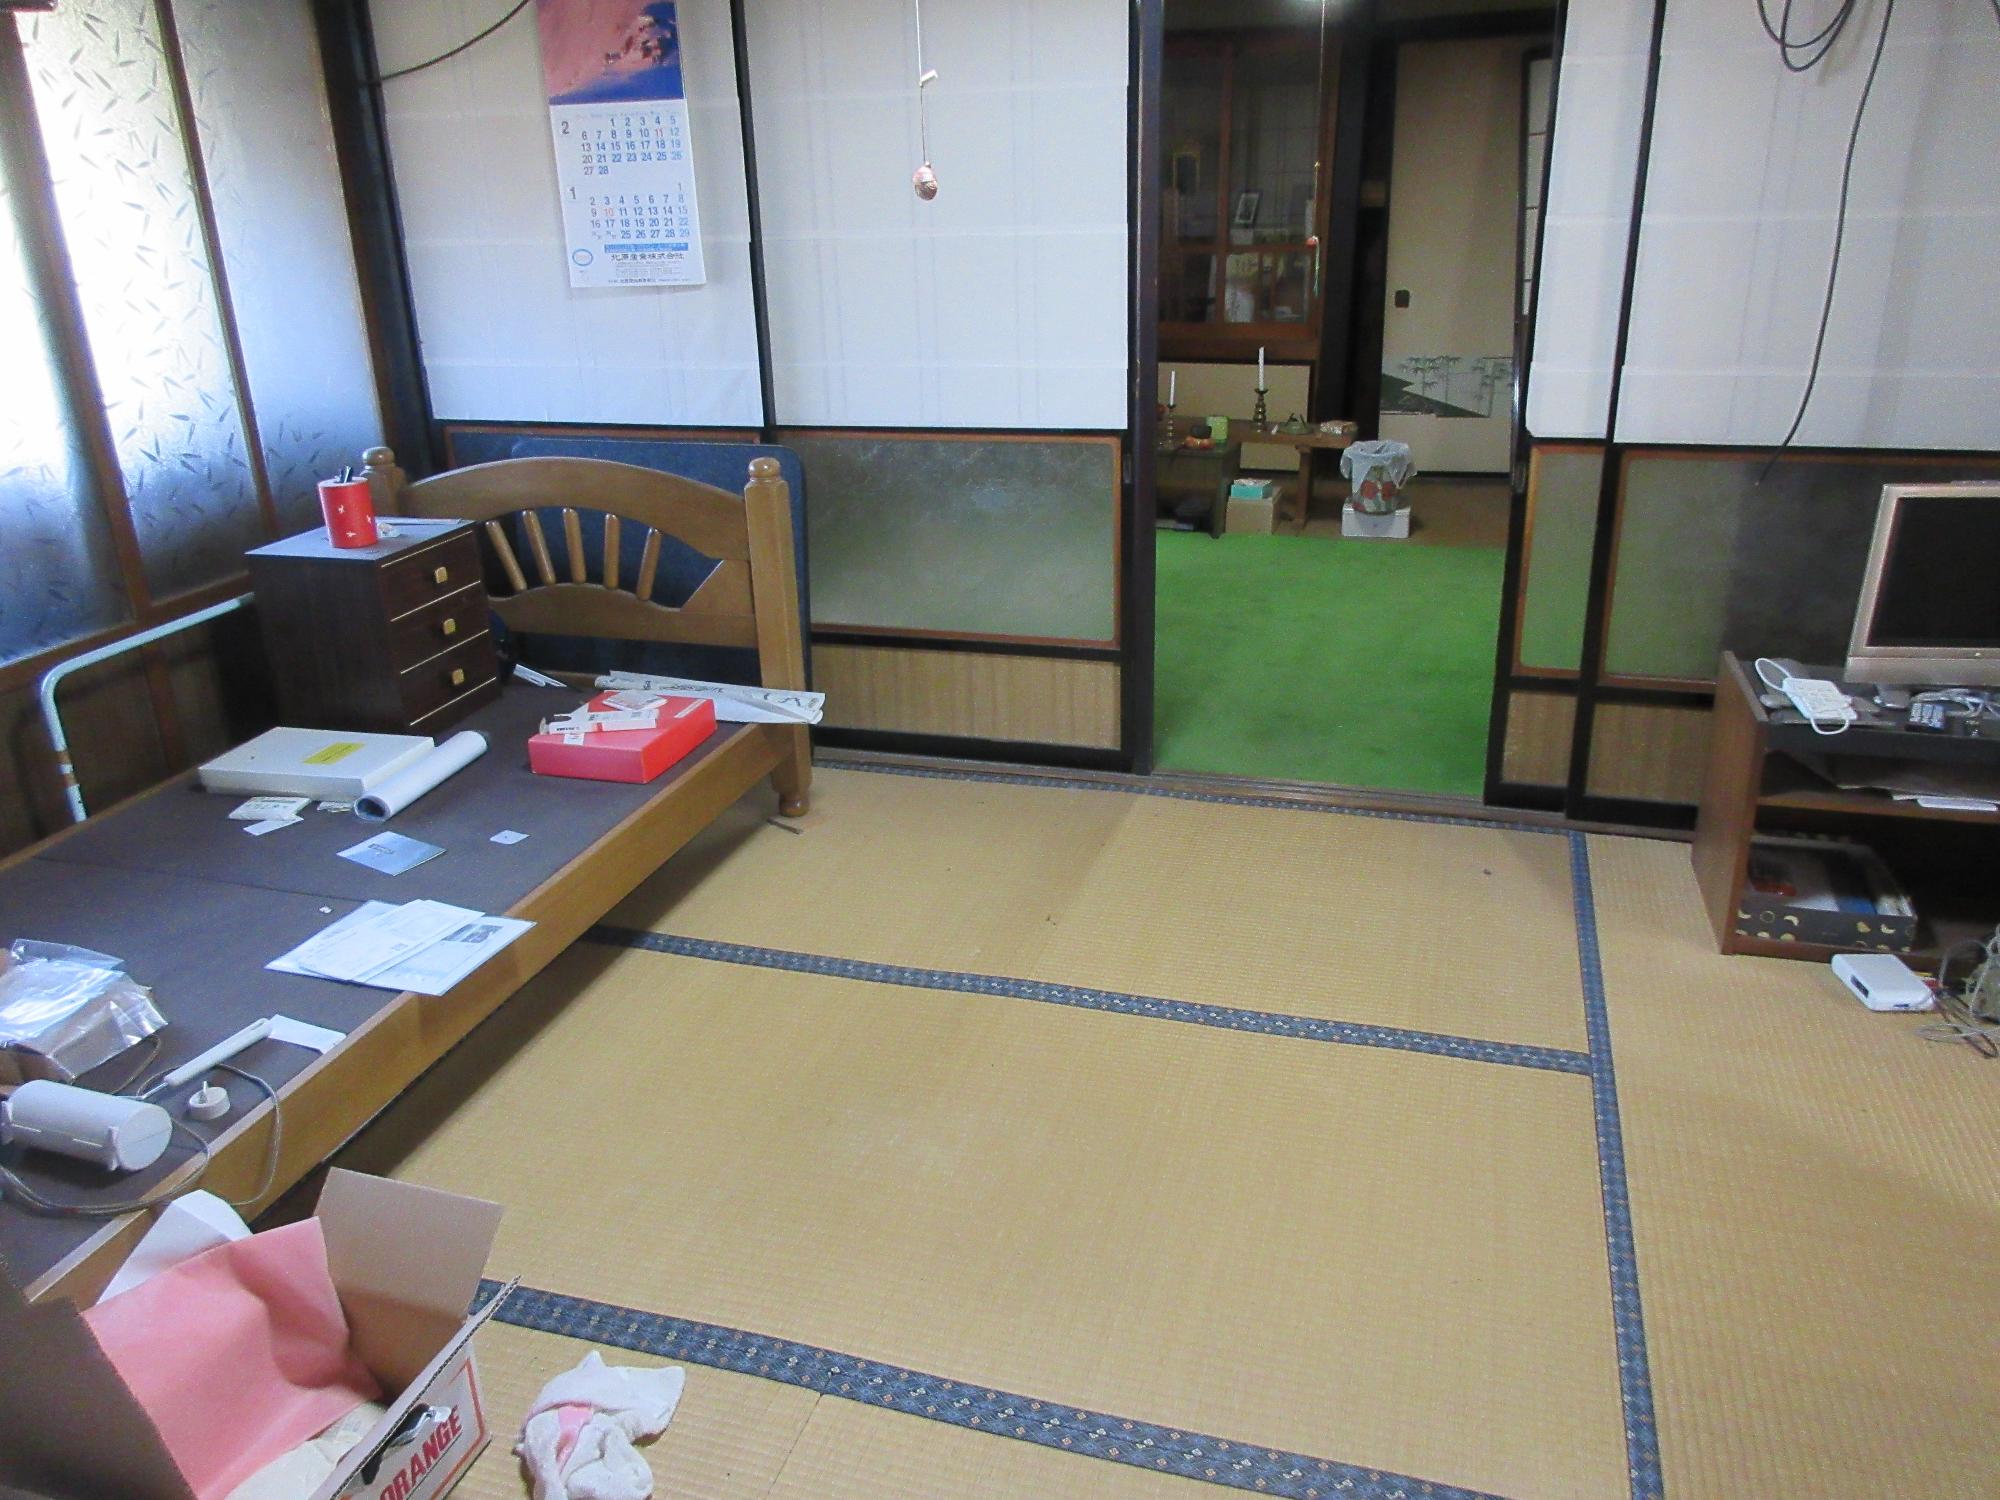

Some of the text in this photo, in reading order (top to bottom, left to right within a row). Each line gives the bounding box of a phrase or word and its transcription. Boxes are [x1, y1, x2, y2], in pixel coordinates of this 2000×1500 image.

[610, 118, 614, 126] 1
[625, 117, 630, 126] 2
[640, 116, 646, 126] 3
[656, 116, 661, 125] 4
[561, 121, 569, 134] 2
[582, 131, 587, 140] 6
[596, 130, 602, 140] 7
[611, 130, 616, 138] 8
[626, 130, 632, 138] 9
[640, 129, 649, 138] 10
[656, 128, 664, 137] 11
[582, 143, 592, 152] 13
[596, 142, 606, 151] 14
[611, 142, 620, 150] 15
[626, 141, 634, 150] 16
[640, 141, 650, 149] 17
[656, 140, 666, 148] 18
[582, 155, 592, 164] 20
[596, 154, 606, 162] 21
[612, 154, 622, 162] 22
[627, 154, 636, 162] 23
[642, 153, 652, 161] 24
[656, 152, 666, 160] 25
[584, 166, 608, 175] 27 28
[570, 186, 576, 200] 1
[590, 194, 684, 206] 2 3 4 5 6 7 8
[592, 208, 597, 216] 9
[605, 208, 614, 216] 10
[619, 207, 628, 216] 11
[634, 207, 643, 216] 12
[648, 206, 658, 215] 13
[663, 206, 672, 214] 14
[592, 220, 600, 228] 16
[606, 219, 615, 228] 17
[620, 218, 630, 227] 18
[635, 218, 644, 226] 19
[649, 218, 659, 226] 20
[664, 218, 674, 226] 21
[620, 230, 632, 239] 25
[636, 230, 646, 238] 26
[650, 230, 660, 238] 27
[664, 230, 676, 238] 28
